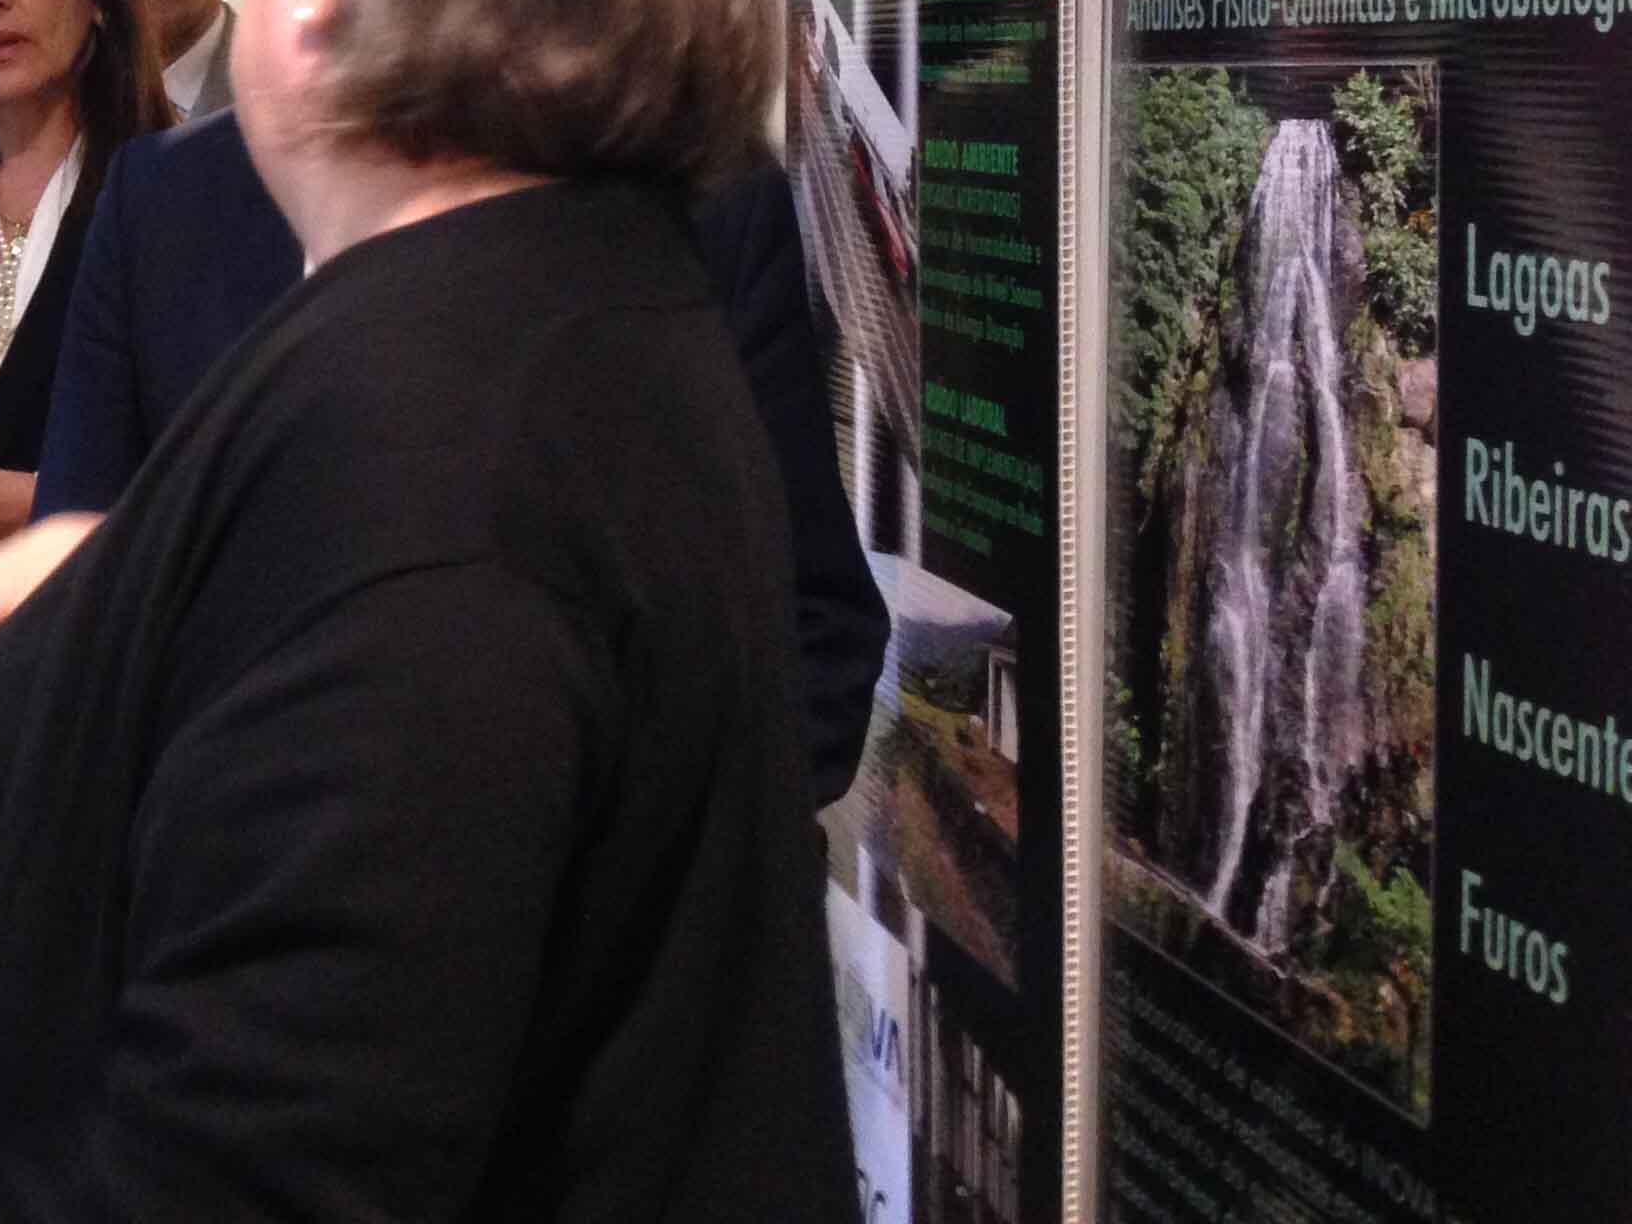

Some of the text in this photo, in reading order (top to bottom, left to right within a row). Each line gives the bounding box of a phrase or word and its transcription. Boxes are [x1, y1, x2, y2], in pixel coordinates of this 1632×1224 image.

[1466, 222, 1611, 336] Lagoas
[1464, 436, 1631, 563] Ribeiras
[1461, 868, 1569, 1005] Furos
